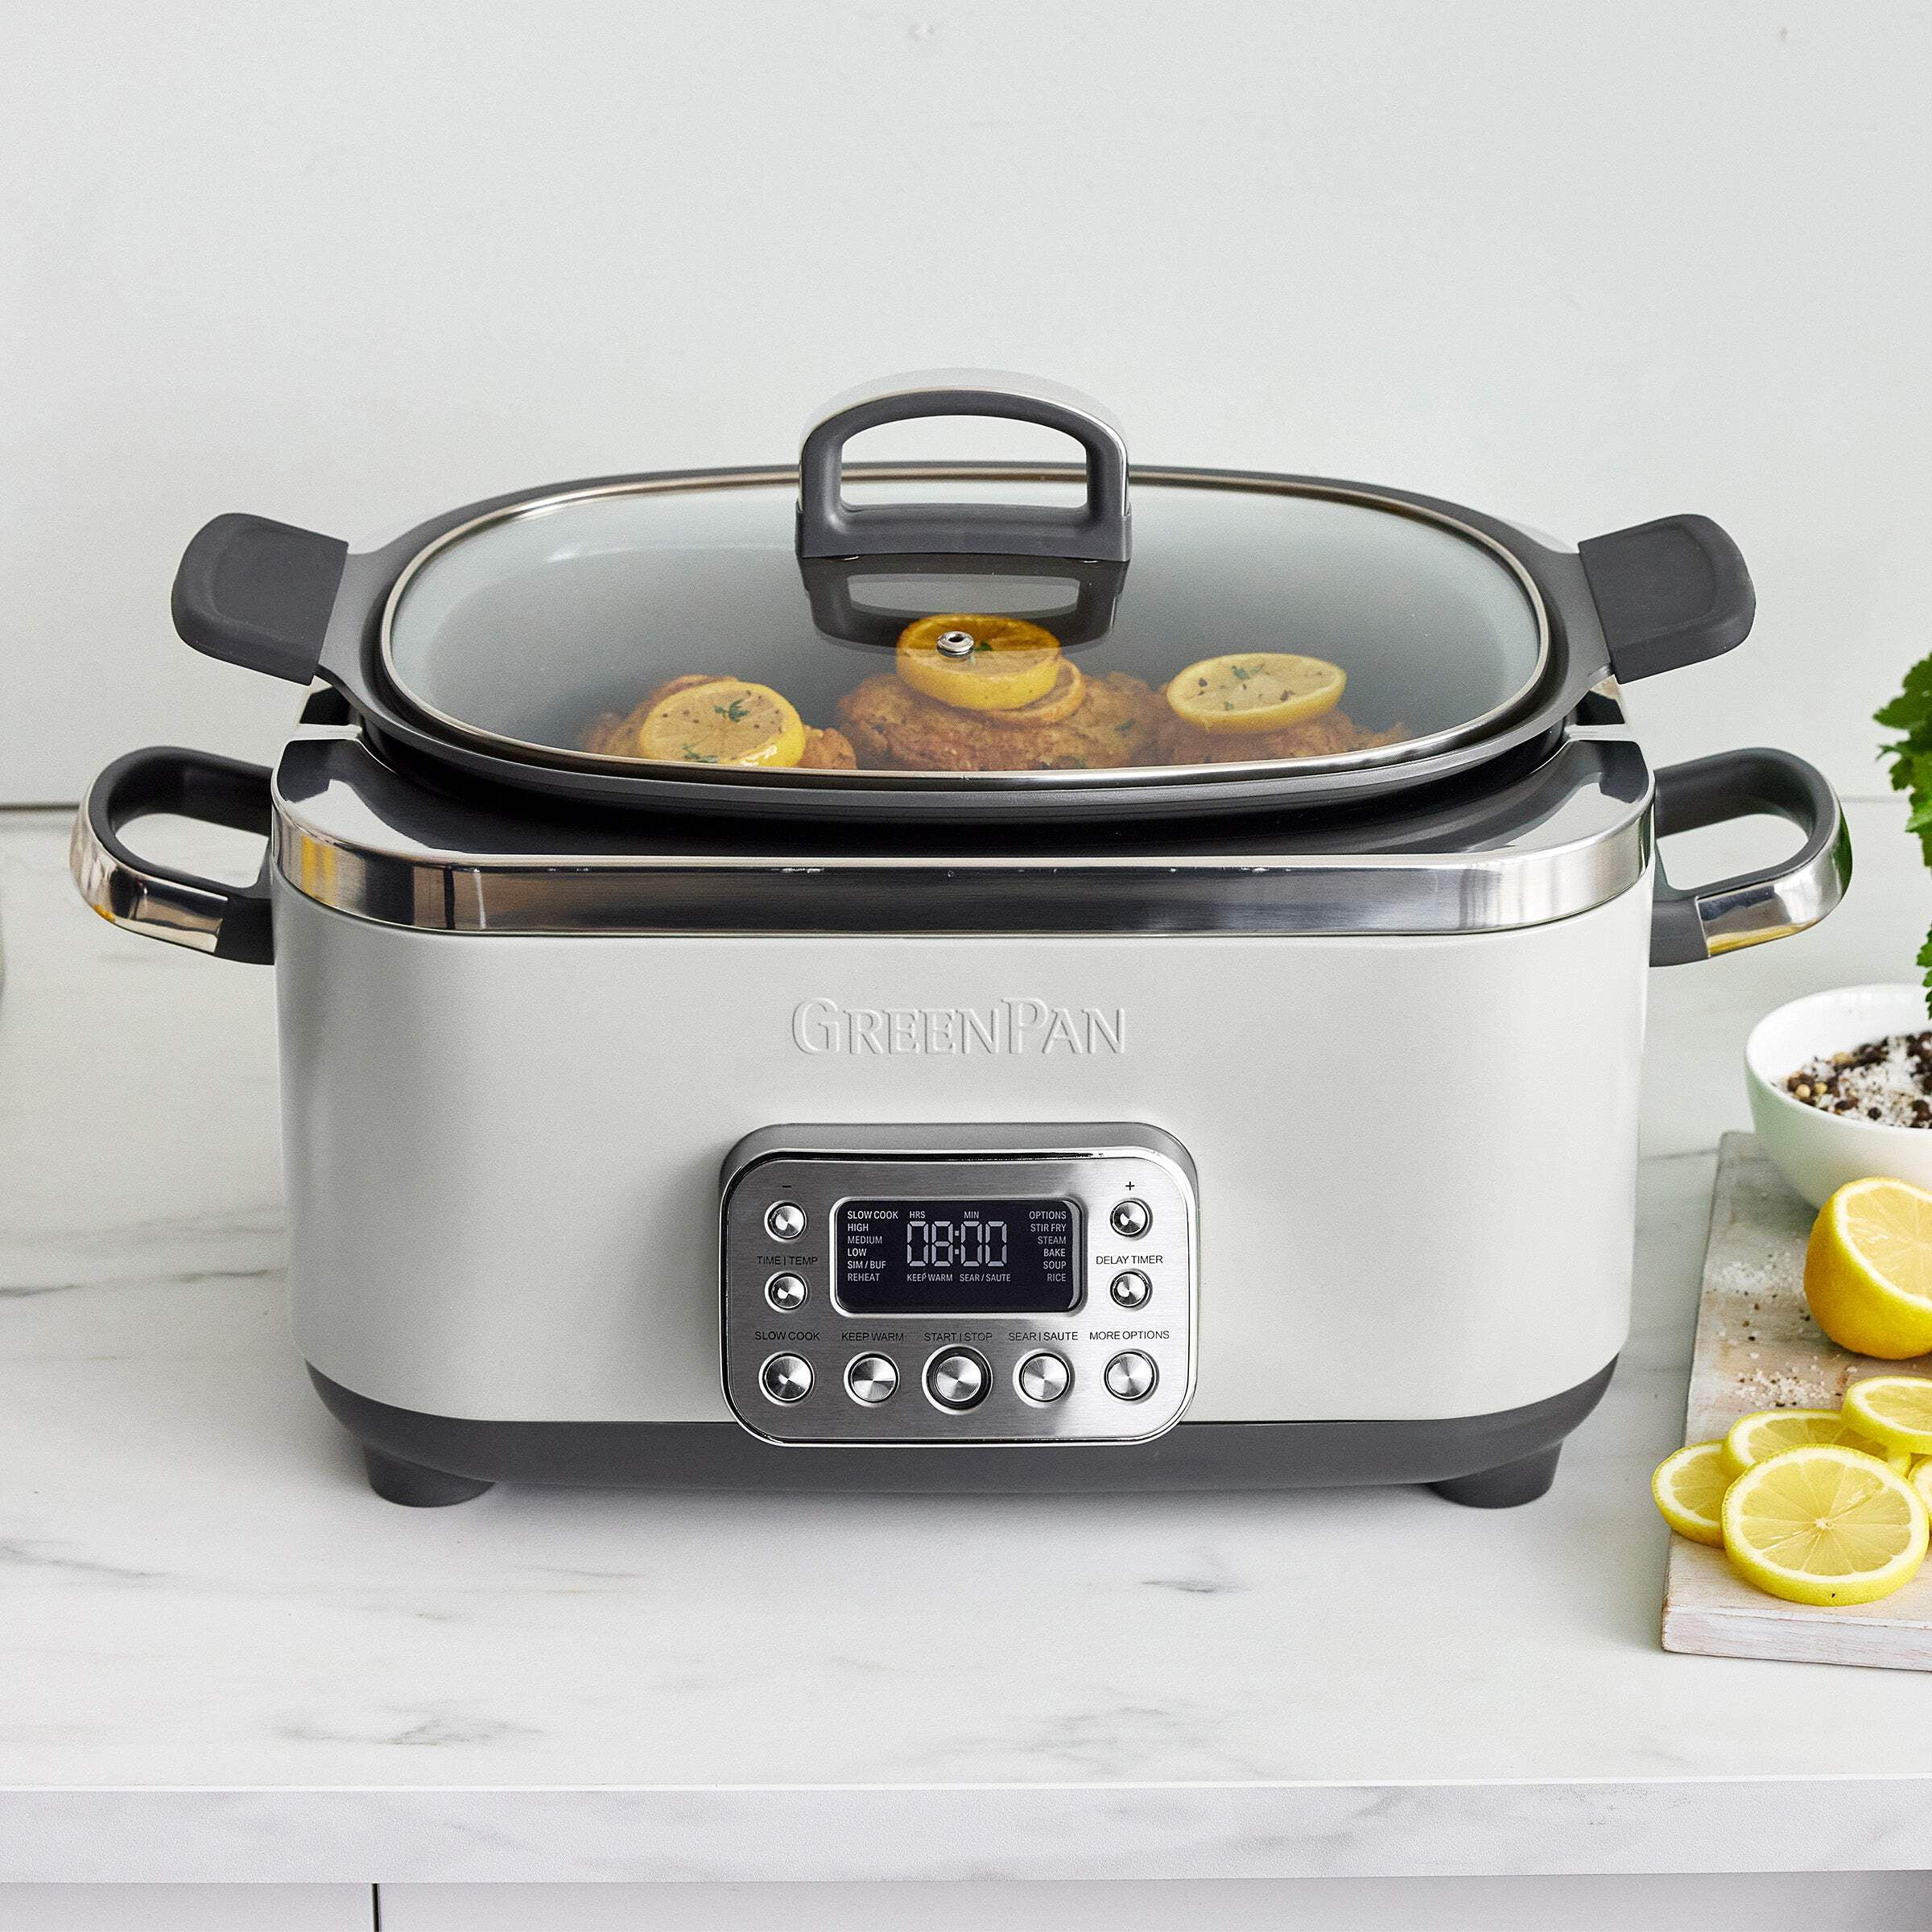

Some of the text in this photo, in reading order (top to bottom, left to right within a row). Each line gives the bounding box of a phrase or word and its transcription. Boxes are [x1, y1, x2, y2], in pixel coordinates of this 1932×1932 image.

[847, 1211, 898, 1220] SLOW COOK
[909, 1211, 926, 1219] HRS
[964, 1211, 980, 1219] MIN
[1029, 1211, 1067, 1220] OPTIONS
[847, 1223, 869, 1232] HIGH
[1030, 1223, 1067, 1232] STIR FRY
[847, 1236, 883, 1245] MEDIUM
[906, 1220, 1007, 1267] 08:00
[1037, 1236, 1067, 1245] STEAM
[847, 1248, 867, 1257] LOW
[1043, 1248, 1066, 1257] BAKE
[757, 1255, 781, 1265] TIME
[789, 1256, 819, 1265] TEMP
[1096, 1255, 1163, 1265] DELAY TIMER
[847, 1261, 864, 1269] SIM
[869, 1261, 886, 1269] BUF
[1042, 1261, 1067, 1269] SOUP
[847, 1273, 881, 1282] REHEAT
[906, 1274, 953, 1282] KEEP WARM
[959, 1274, 980, 1282] SEAR
[985, 1274, 1011, 1282] SAUTE
[1046, 1273, 1067, 1282] RICE
[754, 1331, 820, 1341] SLOW COOK
[841, 1331, 904, 1342] KEEP WARM
[924, 1331, 958, 1342] START
[965, 1331, 993, 1342] STOP
[1008, 1331, 1037, 1341] SEAR
[1043, 1331, 1079, 1341] SAUTE
[1089, 1330, 1170, 1340] MORE OPTIONS
